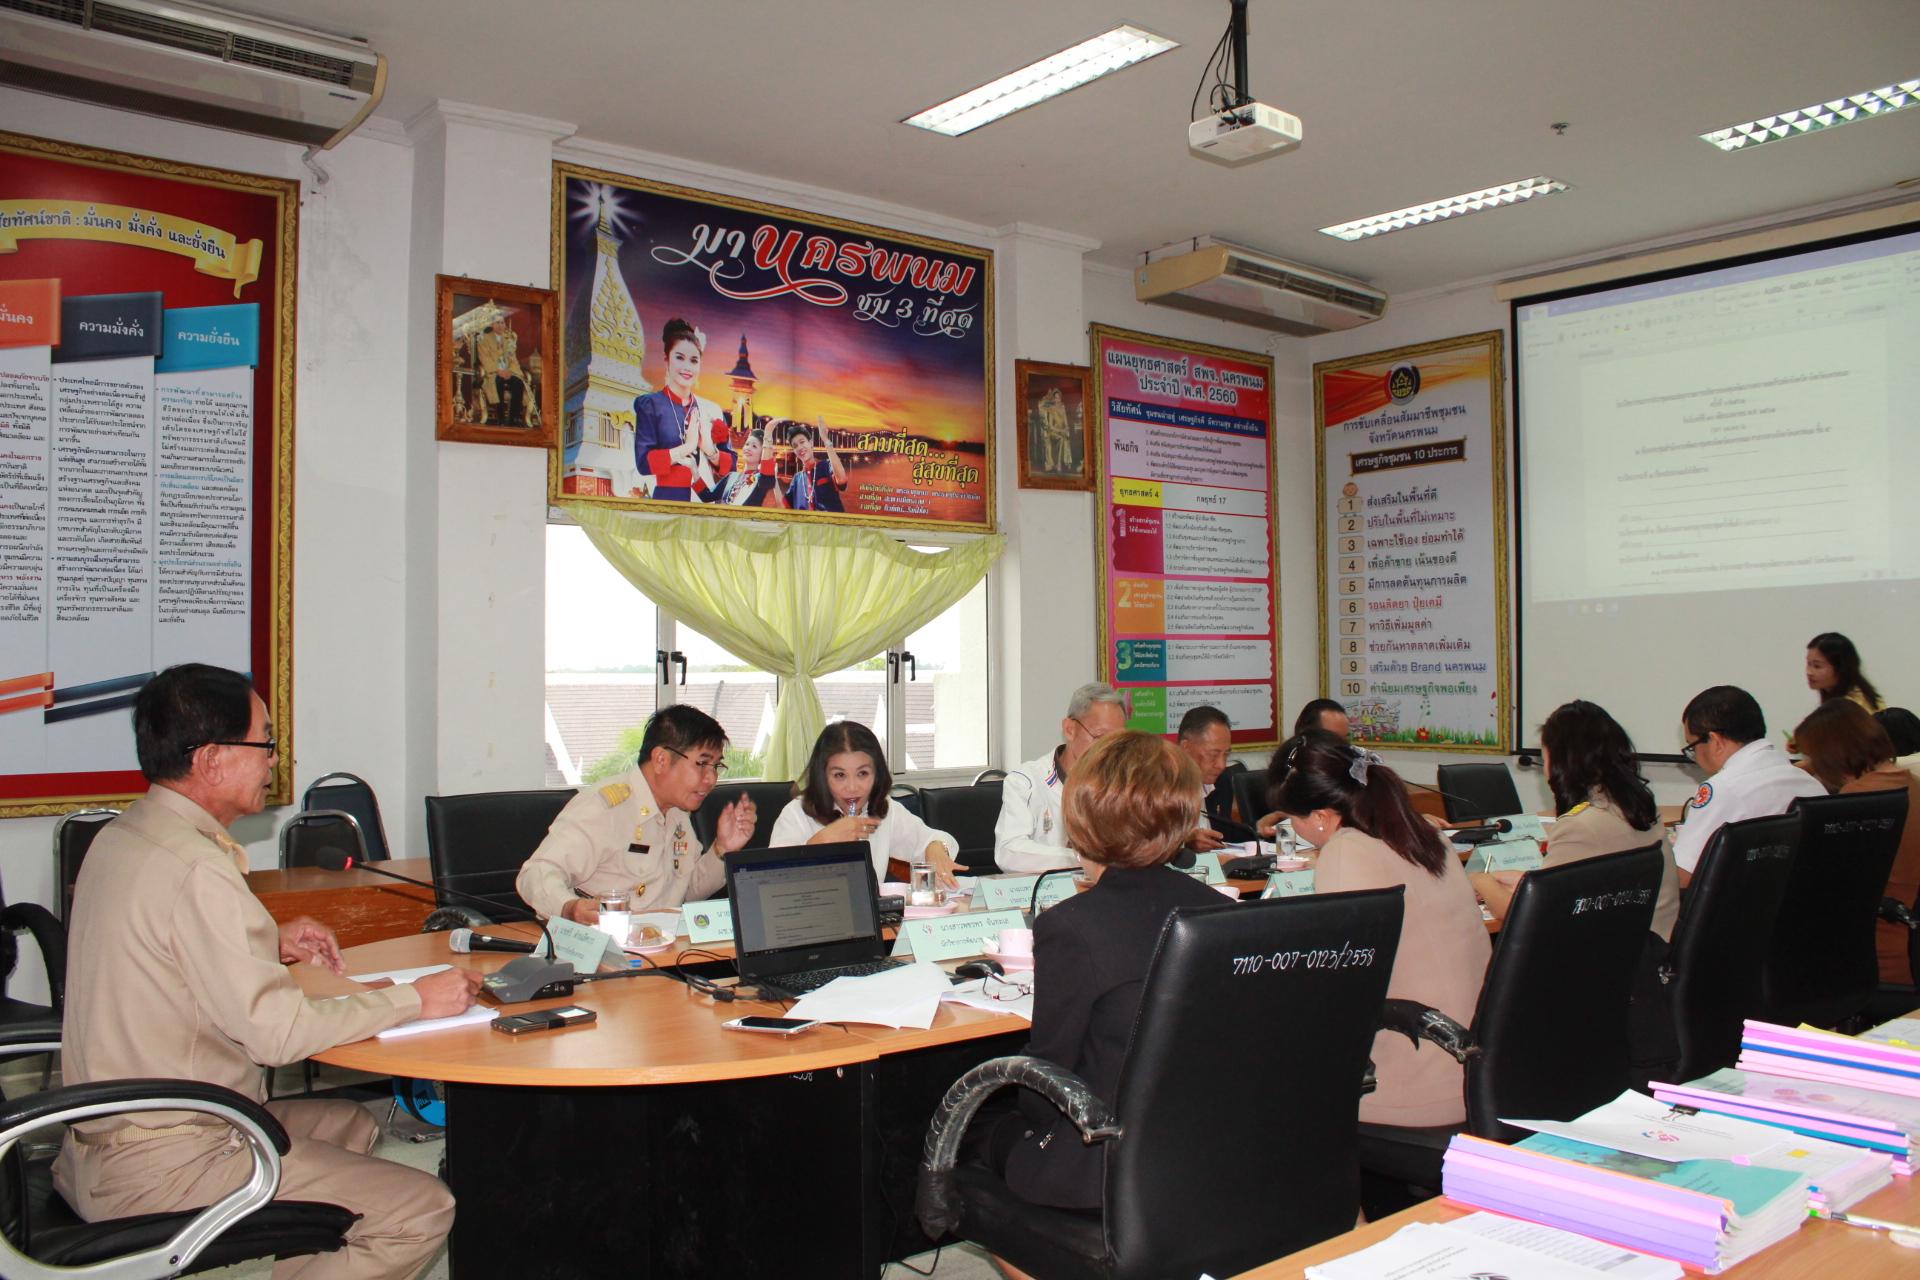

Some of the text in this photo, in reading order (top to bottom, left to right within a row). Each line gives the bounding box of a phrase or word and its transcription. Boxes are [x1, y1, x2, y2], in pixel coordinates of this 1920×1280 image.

[83, 206, 122, 229] มั่นคง
[128, 213, 162, 238] มั่งคั่ง
[168, 229, 226, 259] และยั่งยืน
[853, 286, 979, 338] ชม 3 ที่สุด
[79, 318, 144, 337] ความมั่งคั่ง
[178, 327, 240, 346] ความยั่งยืน
[1107, 350, 1263, 389] แผนยุทธศาสตร์ สพจ. นครพนม
[1139, 375, 1237, 404] ประจำปี พ.ศ. 2560
[1111, 401, 1142, 416] วิสัยทัศน์
[1343, 405, 1466, 431] การขับเคลื่อนสัมมาชีพชุมชน
[1114, 438, 1139, 453] พันธกิจ
[1368, 426, 1438, 444] จังหวัดนครพนม
[1355, 446, 1458, 468] เศรษฐกิจชุมชน 10 ประการ
[912, 455, 979, 489] สู่สุขที่สุด
[1348, 485, 1437, 510] 1 ส่งเสริมในพื้นที่ดี
[1348, 508, 1456, 531] 2 ปรับในพื้นที่ไม่เหมาะ
[1348, 528, 1464, 551] 3 เฉพาะใช้เอง ย่อมทำได้
[1348, 551, 1457, 571] 4 เพื่อค้าขาย เน้นของดี
[1349, 573, 1467, 592] 5 มีการลดต้นทุนการผลิต
[1118, 581, 1131, 608] 2
[1349, 602, 1356, 613] 6
[1412, 595, 1442, 612] ปุ๋ยเคมี
[1350, 616, 1432, 634] 7 หาวิธีเพิ่มมูลค่า
[1350, 635, 1470, 652] 8 ช่วยกันหาตลาดเพิ่มเติม
[1118, 642, 1131, 669] 3
[1350, 660, 1486, 672] 9 เสริมด้วย Brand นครพนม
[1347, 681, 1477, 698] 10 ค่านิยมเศรษฐกิจพอเพียง
[1233, 941, 1376, 975] 7110-007-0123/2558
